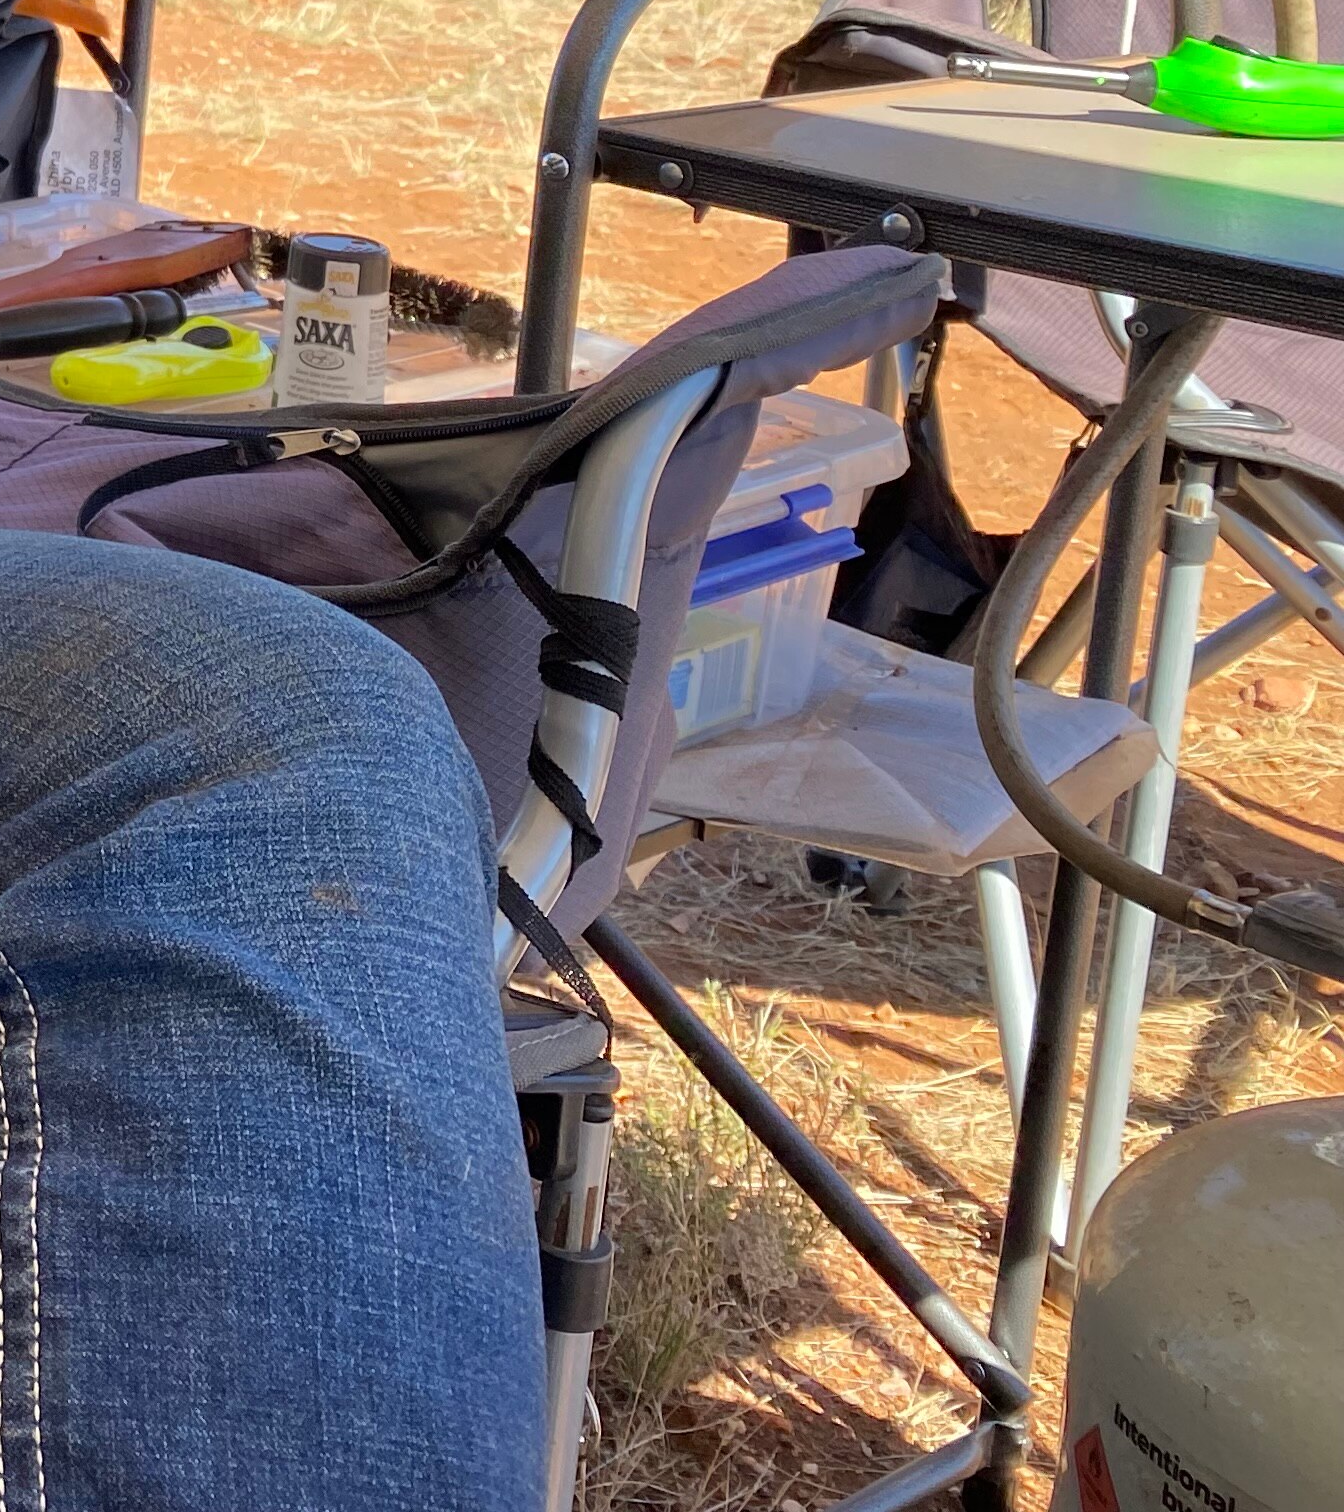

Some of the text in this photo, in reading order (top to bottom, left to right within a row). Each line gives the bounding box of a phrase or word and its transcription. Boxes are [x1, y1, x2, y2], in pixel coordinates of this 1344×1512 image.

[62, 167, 76, 186] by
[99, 149, 111, 189] Avenue
[293, 315, 356, 356] SAXA
[1113, 1400, 1236, 1512] Intentional
